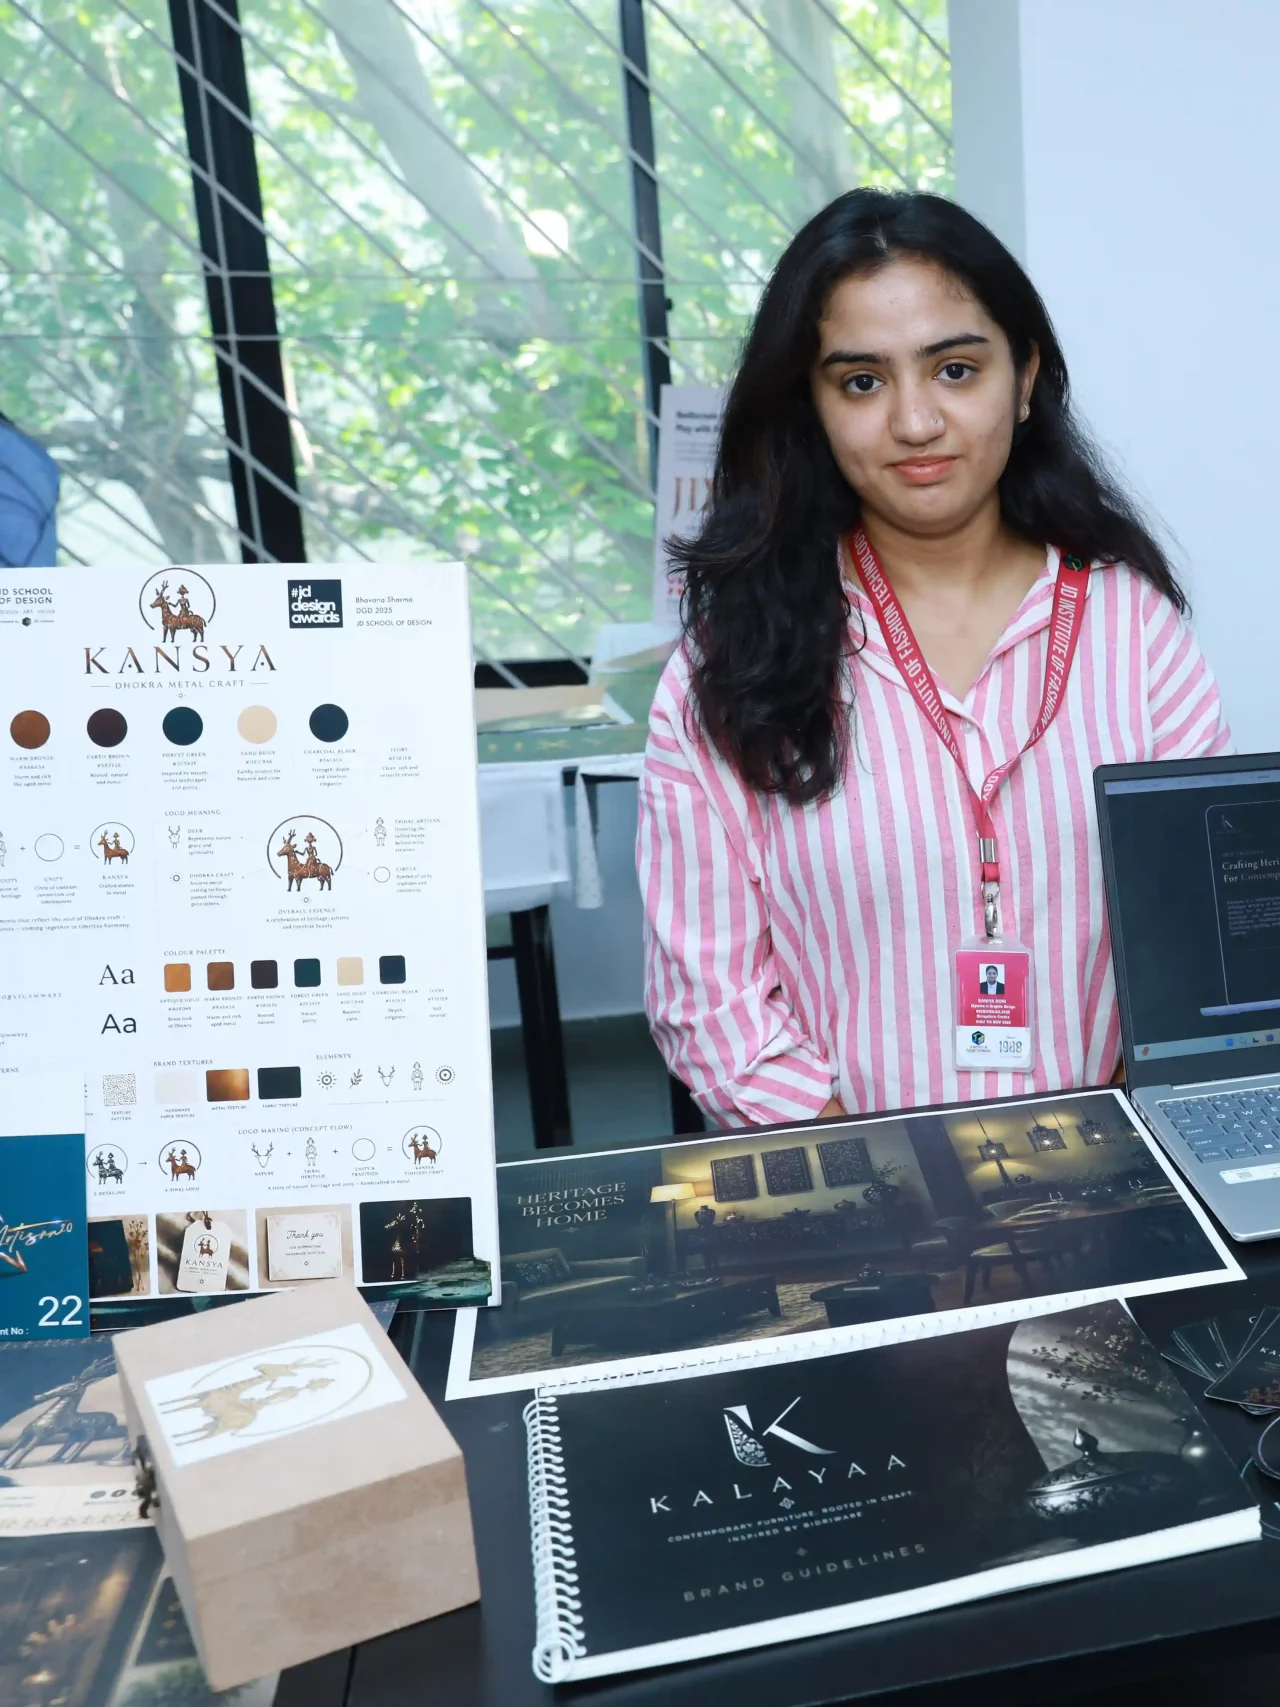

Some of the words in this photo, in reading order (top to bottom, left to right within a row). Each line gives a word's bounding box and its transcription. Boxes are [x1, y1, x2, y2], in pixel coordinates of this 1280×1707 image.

[853, 528, 890, 606] TECHNOLOGY
[12, 587, 53, 596] SCHOOL
[291, 585, 312, 600] #jd
[355, 596, 386, 604] Bhavana
[1062, 582, 1078, 599] JD
[291, 599, 337, 614] design
[291, 611, 340, 624] awards
[882, 605, 914, 660] FASHION
[1054, 599, 1077, 660] INSTITUTE
[83, 644, 277, 674] KANSYA
[904, 657, 922, 678] OF
[1051, 659, 1064, 680] OF
[115, 680, 163, 690] DHOKRA
[169, 680, 204, 689] METAL
[209, 679, 245, 688] CRAFT
[914, 675, 951, 746] INSTITUTE
[1041, 675, 1062, 729] FASHION
[1222, 860, 1259, 871] Crafting
[1223, 874, 1239, 883] For
[98, 964, 136, 986] Aa
[101, 1013, 137, 1035] Aa
[998, 1040, 1022, 1053] 1988
[292, 1125, 328, 1134] (CONCEPT
[330, 1124, 353, 1132] FLOW)
[517, 1182, 626, 1205] HERITAGE
[522, 1195, 625, 1217] BECOMES
[535, 1209, 607, 1228] HOME
[286, 1229, 309, 1240] Thank
[310, 1232, 324, 1240] you
[185, 1258, 223, 1269] KANSYA
[38, 1295, 83, 1327] 22
[10, 1327, 24, 1336] No
[649, 1454, 907, 1514] KALAYAA
[667, 1522, 753, 1543] CONTEMPORARY
[822, 1501, 863, 1514] ROOTED
[728, 1528, 780, 1543] INSPIRED
[784, 1524, 798, 1533] BY
[803, 1511, 864, 1529] BIDRIWARE
[683, 1576, 766, 1602] BRAND
[782, 1542, 927, 1583] GUIDELINES
